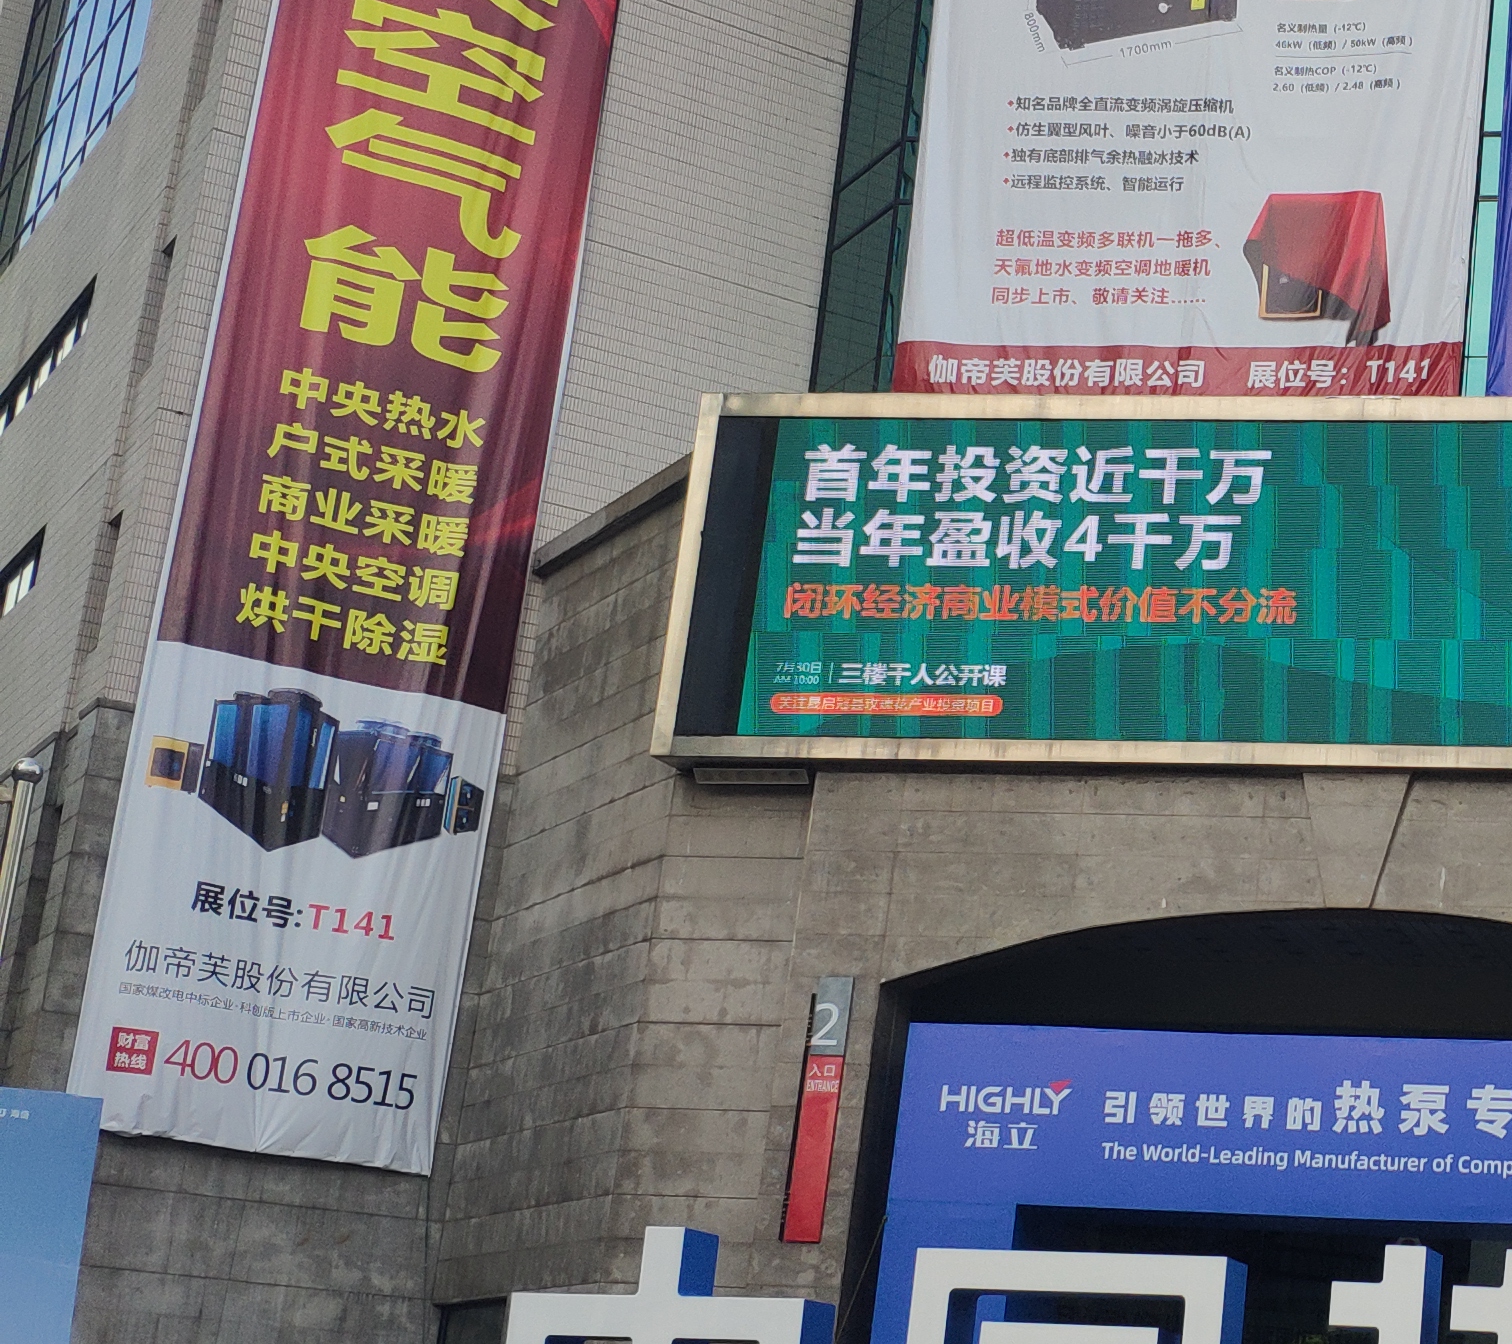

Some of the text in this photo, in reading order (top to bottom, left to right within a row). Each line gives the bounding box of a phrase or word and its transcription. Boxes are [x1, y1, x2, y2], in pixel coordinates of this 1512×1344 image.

[1024, 12, 1045, 53] 800mm
[1119, 39, 1172, 58] 1700mm
[1015, 96, 1234, 115] 知名品牌全直流变频涡旋压缩机
[1011, 148, 1200, 165] 独有底部排气余热融冰技术
[993, 257, 1212, 278] 天氟地水变频空调地暖机
[927, 354, 1206, 389] 伽帝芙股份有限公司
[279, 367, 487, 449] 中央热水
[266, 422, 479, 506] 户式采暖
[803, 442, 1273, 505] 首年投资近千万
[257, 474, 471, 558] 商业采暖
[791, 508, 1242, 572] 当年盈收4千万
[249, 530, 460, 612] 中央空调
[784, 582, 1299, 626] 闭环经济商业模式价值不分流
[236, 582, 450, 666] 烘干除湿
[838, 662, 1008, 687] 三楼千人公开课
[124, 938, 437, 1020] 伽帝芙股份有限公司
[116, 1032, 150, 1051] 财富
[810, 1003, 839, 1046] 2
[113, 1052, 148, 1071] 热线
[164, 1039, 419, 1110] 400 016 8515
[808, 1063, 836, 1077] 入口
[806, 1079, 840, 1093] ENTRANCE
[939, 1080, 1072, 1116] HIGHLY
[964, 1119, 1039, 1151] 海立
[1101, 1142, 1137, 1161] The
[1142, 1143, 1289, 1171] World-Leading
[1294, 1149, 1428, 1173] Manufacturer
[1432, 1154, 1454, 1173] of
